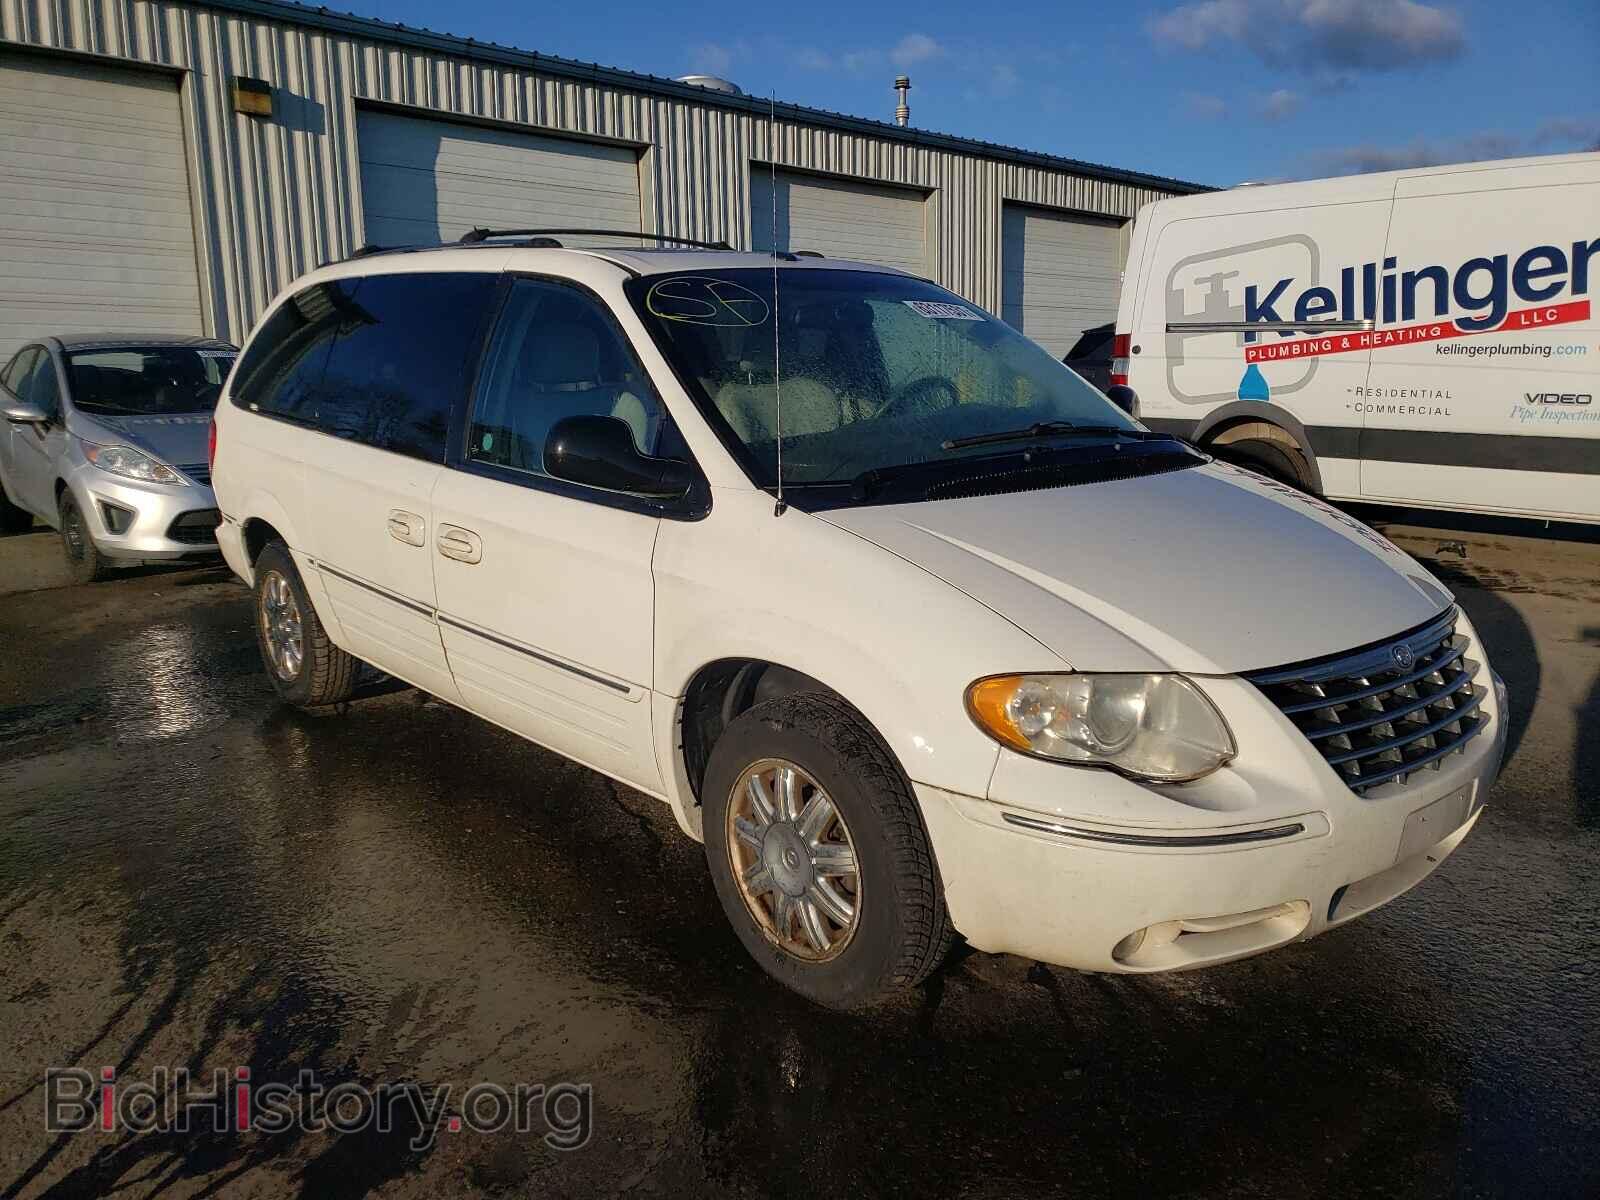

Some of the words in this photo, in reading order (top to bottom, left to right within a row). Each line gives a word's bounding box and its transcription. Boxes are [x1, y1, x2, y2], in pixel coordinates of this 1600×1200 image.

[1244, 237, 1600, 343] Kellinger
[1248, 340, 1333, 360] PLUMBING
[1341, 337, 1351, 349] &
[1360, 326, 1442, 346] HEATING
[1520, 308, 1559, 326] LLC
[1435, 343, 1588, 358] kellingerplumbing.com
[1355, 386, 1453, 399] RESIDENTIAL
[1525, 392, 1593, 405] VIDEO
[1354, 402, 1452, 416] COMMERCIAL
[1509, 405, 1537, 423] Pipe
